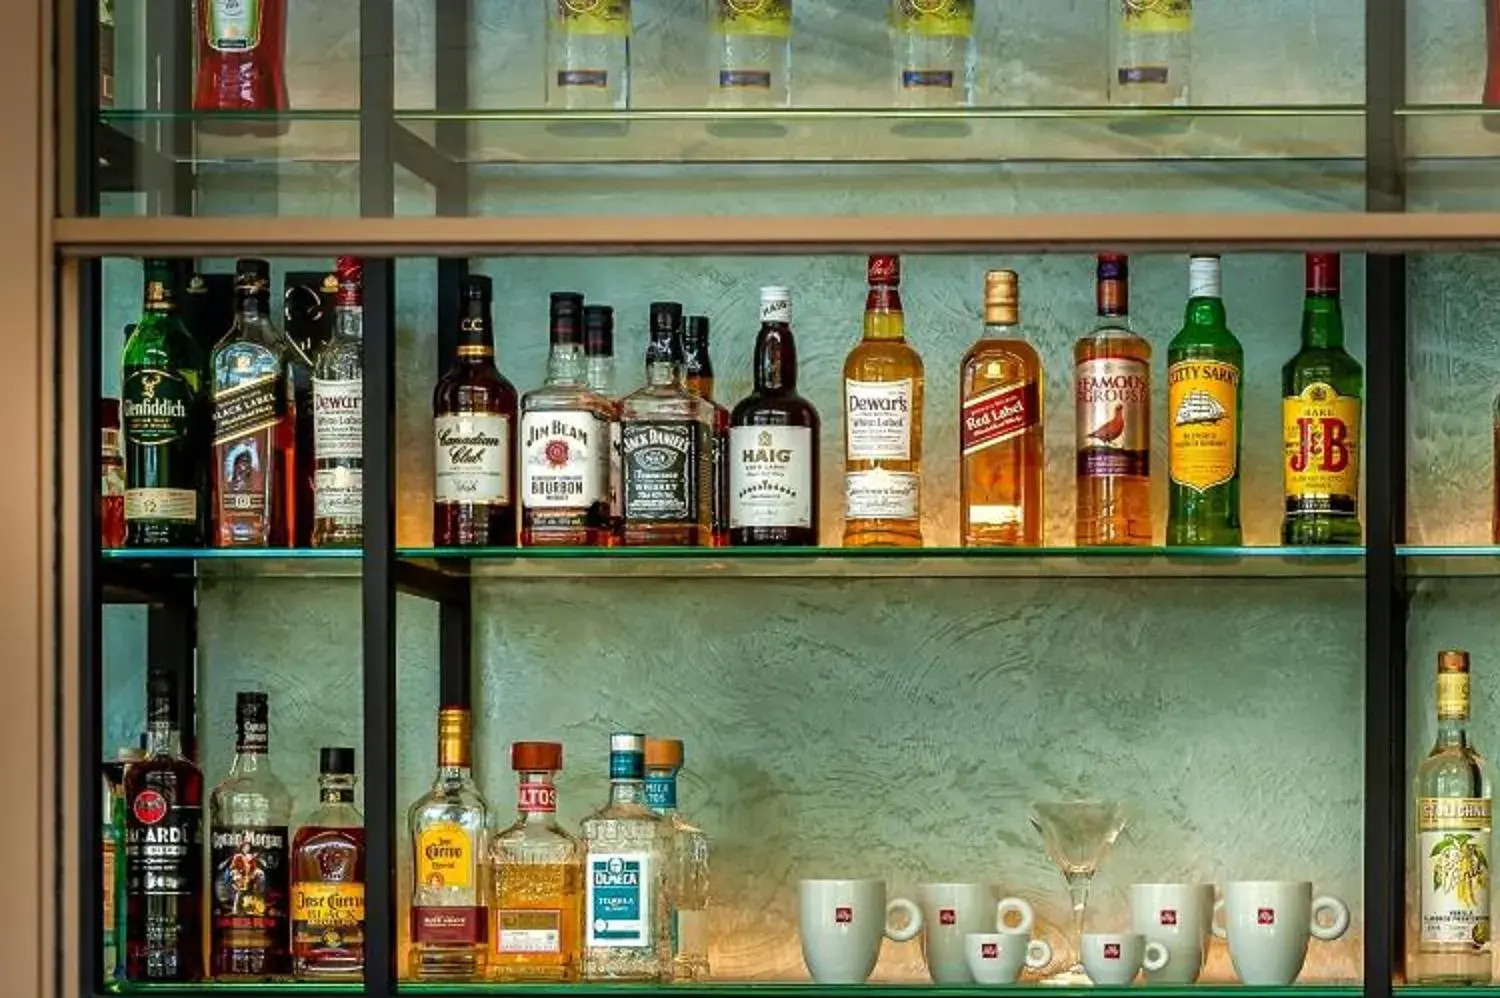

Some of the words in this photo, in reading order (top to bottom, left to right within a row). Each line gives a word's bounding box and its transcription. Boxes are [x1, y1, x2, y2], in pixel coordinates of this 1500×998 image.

[316, 394, 361, 411] Dewar
[849, 395, 908, 413] Dewar's
[966, 413, 990, 430] Red
[991, 401, 1025, 421] Label
[437, 427, 499, 447] Canadian
[526, 425, 549, 447] JIM
[552, 420, 588, 445] BEAM
[624, 434, 648, 453] JACK
[1290, 417, 1349, 472] J&B
[450, 446, 486, 464] Club
[742, 449, 792, 463] HAIG
[531, 481, 583, 495] BOURBON
[520, 789, 556, 805] LTOS
[242, 829, 283, 849] Morgan
